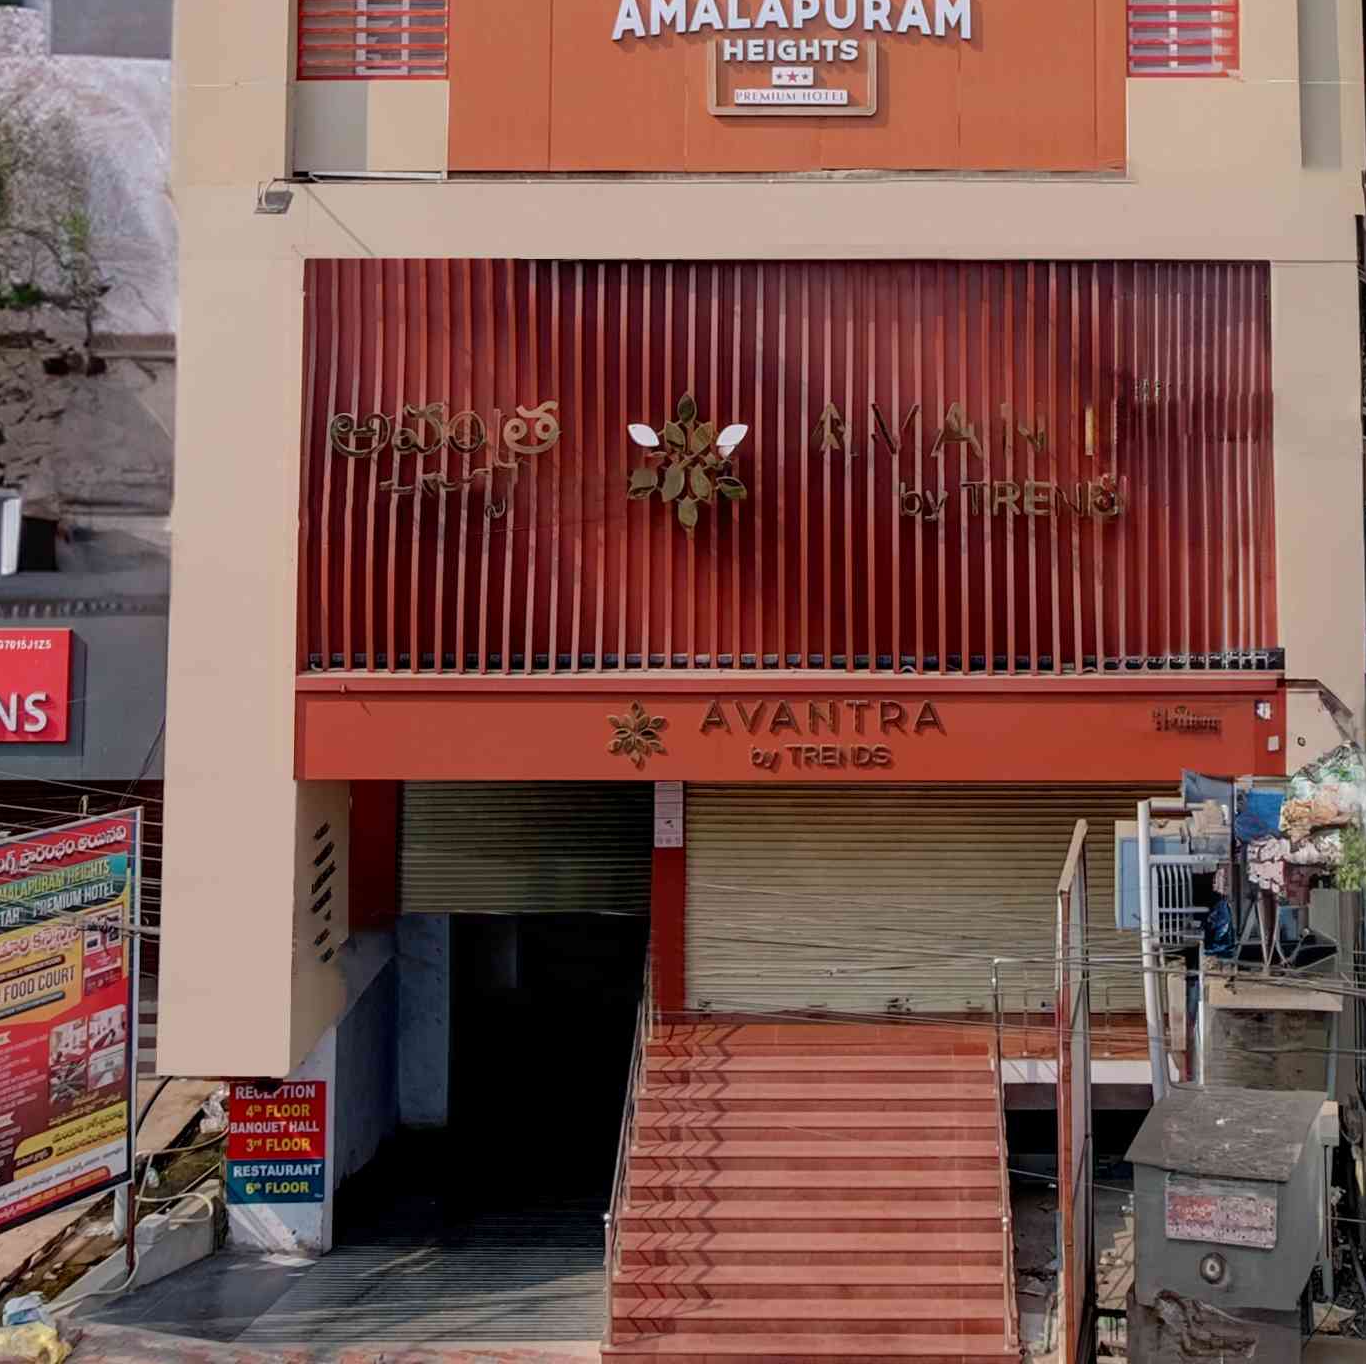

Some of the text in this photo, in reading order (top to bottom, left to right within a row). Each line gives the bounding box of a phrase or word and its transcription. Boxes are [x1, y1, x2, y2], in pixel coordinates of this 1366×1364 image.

[722, 39, 859, 62] HEIGHTS
[735, 90, 847, 103] PREMIUM HOTEL
[899, 481, 948, 521] by
[698, 699, 948, 736] AVANTRA
[751, 743, 893, 772] by TRENDS
[67, 859, 111, 883] HEIGHTS
[33, 890, 82, 918] PREMIUM
[84, 881, 116, 903] HOTEL
[3, 978, 35, 1003] FOOD
[37, 965, 76, 992] COURT
[245, 1103, 311, 1117] 4th FLOOR
[230, 1120, 320, 1134] BANQUET HALL
[245, 1138, 312, 1152] 3rd FLOOR
[233, 1163, 322, 1178] RESTAURANT
[265, 1181, 310, 1194] FLOOR
